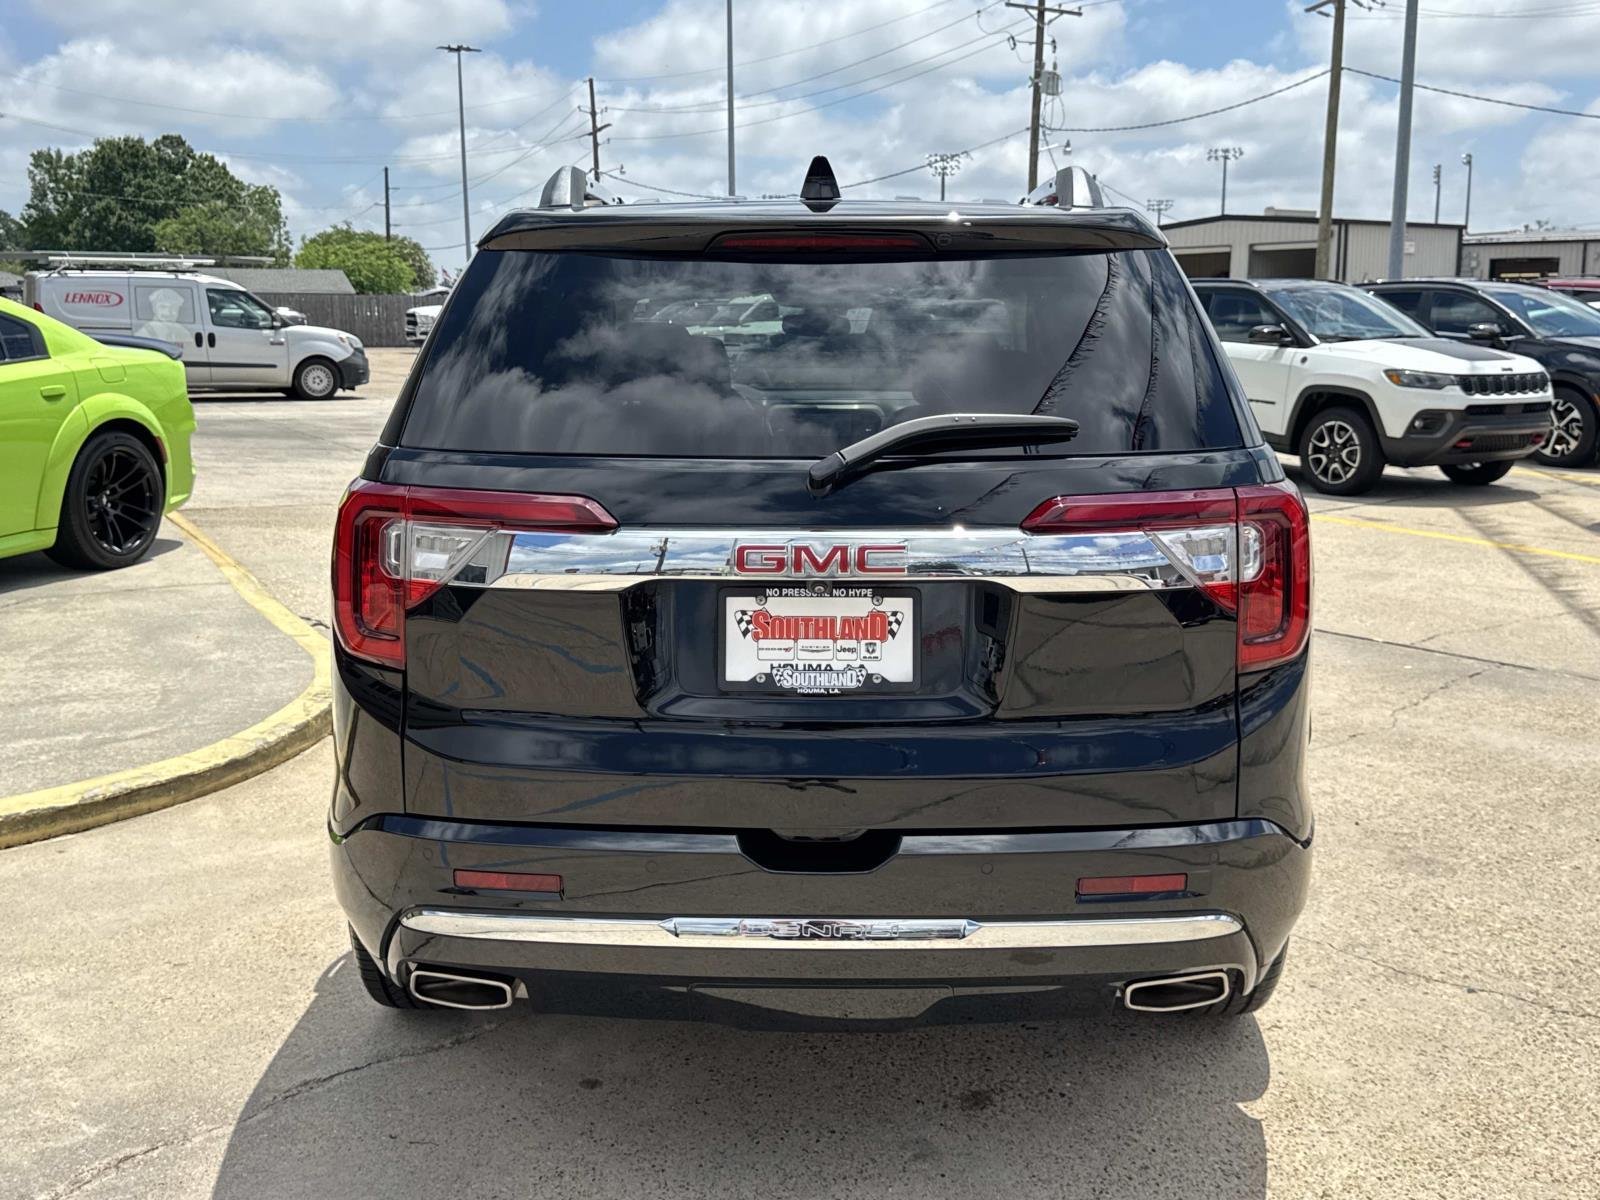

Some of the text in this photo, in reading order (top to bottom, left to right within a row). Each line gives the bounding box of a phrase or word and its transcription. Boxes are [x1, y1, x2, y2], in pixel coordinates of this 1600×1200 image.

[64, 292, 112, 305] LENNOX
[734, 544, 908, 575] GMC
[766, 588, 873, 597] NO PRESS NO HYPE
[752, 610, 888, 642] SOUTHLAND
[837, 645, 857, 654] Jeep
[782, 669, 857, 687] SOUTHLAND
